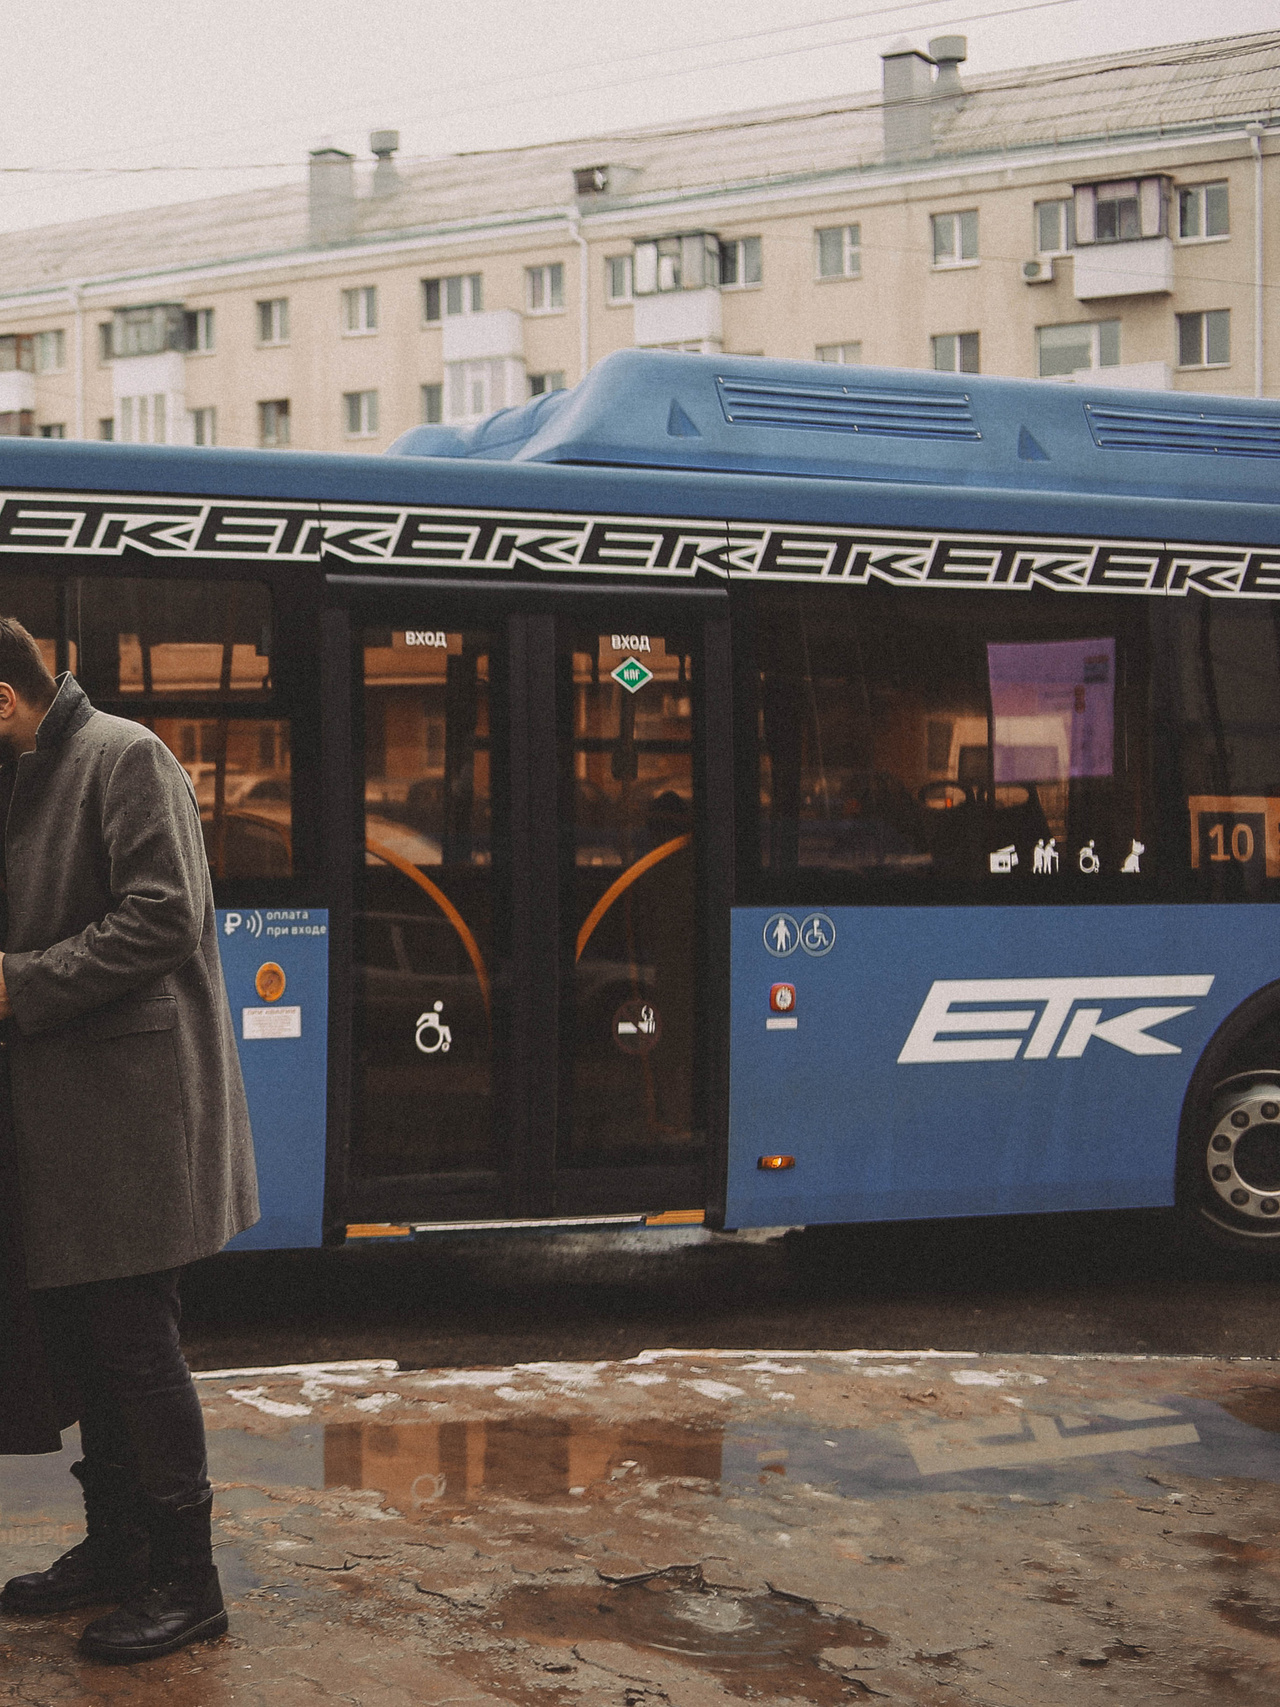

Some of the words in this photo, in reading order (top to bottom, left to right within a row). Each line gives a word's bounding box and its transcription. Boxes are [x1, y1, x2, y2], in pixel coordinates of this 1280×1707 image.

[405, 631, 447, 648] ВХОД
[612, 634, 651, 653] ВХОД
[1209, 823, 1254, 862] 10
[266, 910, 309, 920] оплата
[266, 926, 288, 938] при
[292, 925, 326, 936] входе
[896, 974, 1215, 1065] ЕТК
